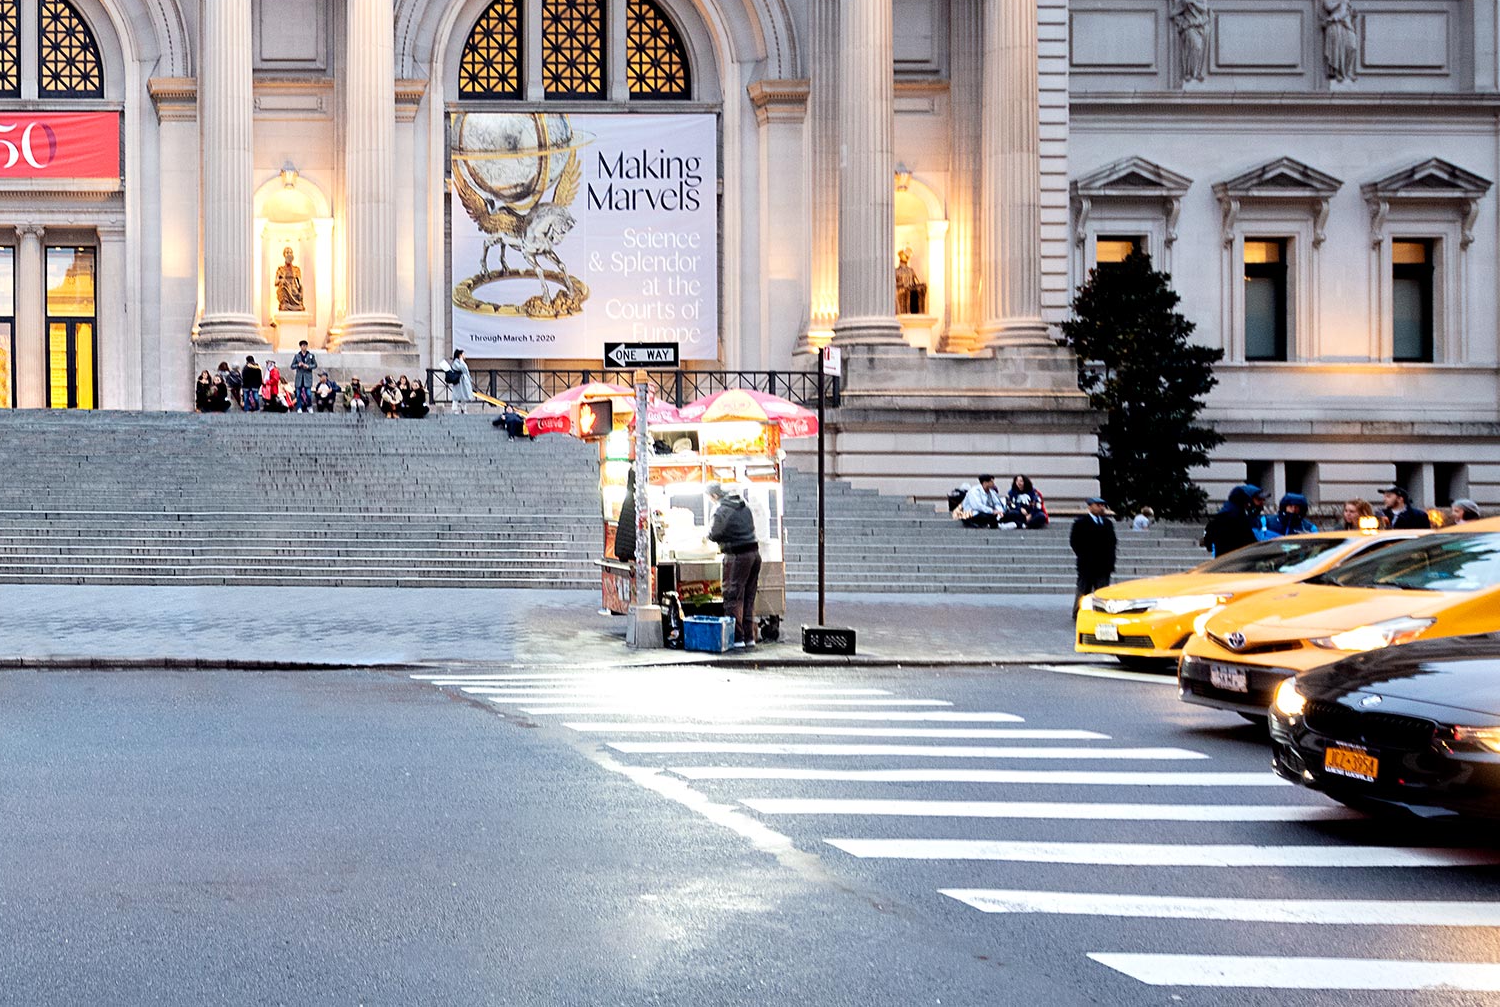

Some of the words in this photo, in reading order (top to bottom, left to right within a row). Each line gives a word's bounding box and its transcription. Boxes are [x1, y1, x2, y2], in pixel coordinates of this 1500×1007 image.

[598, 149, 702, 187] Making
[587, 181, 700, 211] Marvels
[623, 227, 700, 248] Science
[588, 251, 604, 272] &
[610, 251, 701, 277] Splendor
[642, 276, 660, 296] at
[668, 275, 700, 296] the
[605, 299, 675, 320] Courts
[681, 299, 703, 320] of
[470, 334, 502, 343] Through
[503, 334, 528, 342] March
[536, 334, 555, 342] 2020
[633, 322, 700, 343] Europe
[616, 350, 636, 360] ONE
[647, 350, 669, 360] WAY
